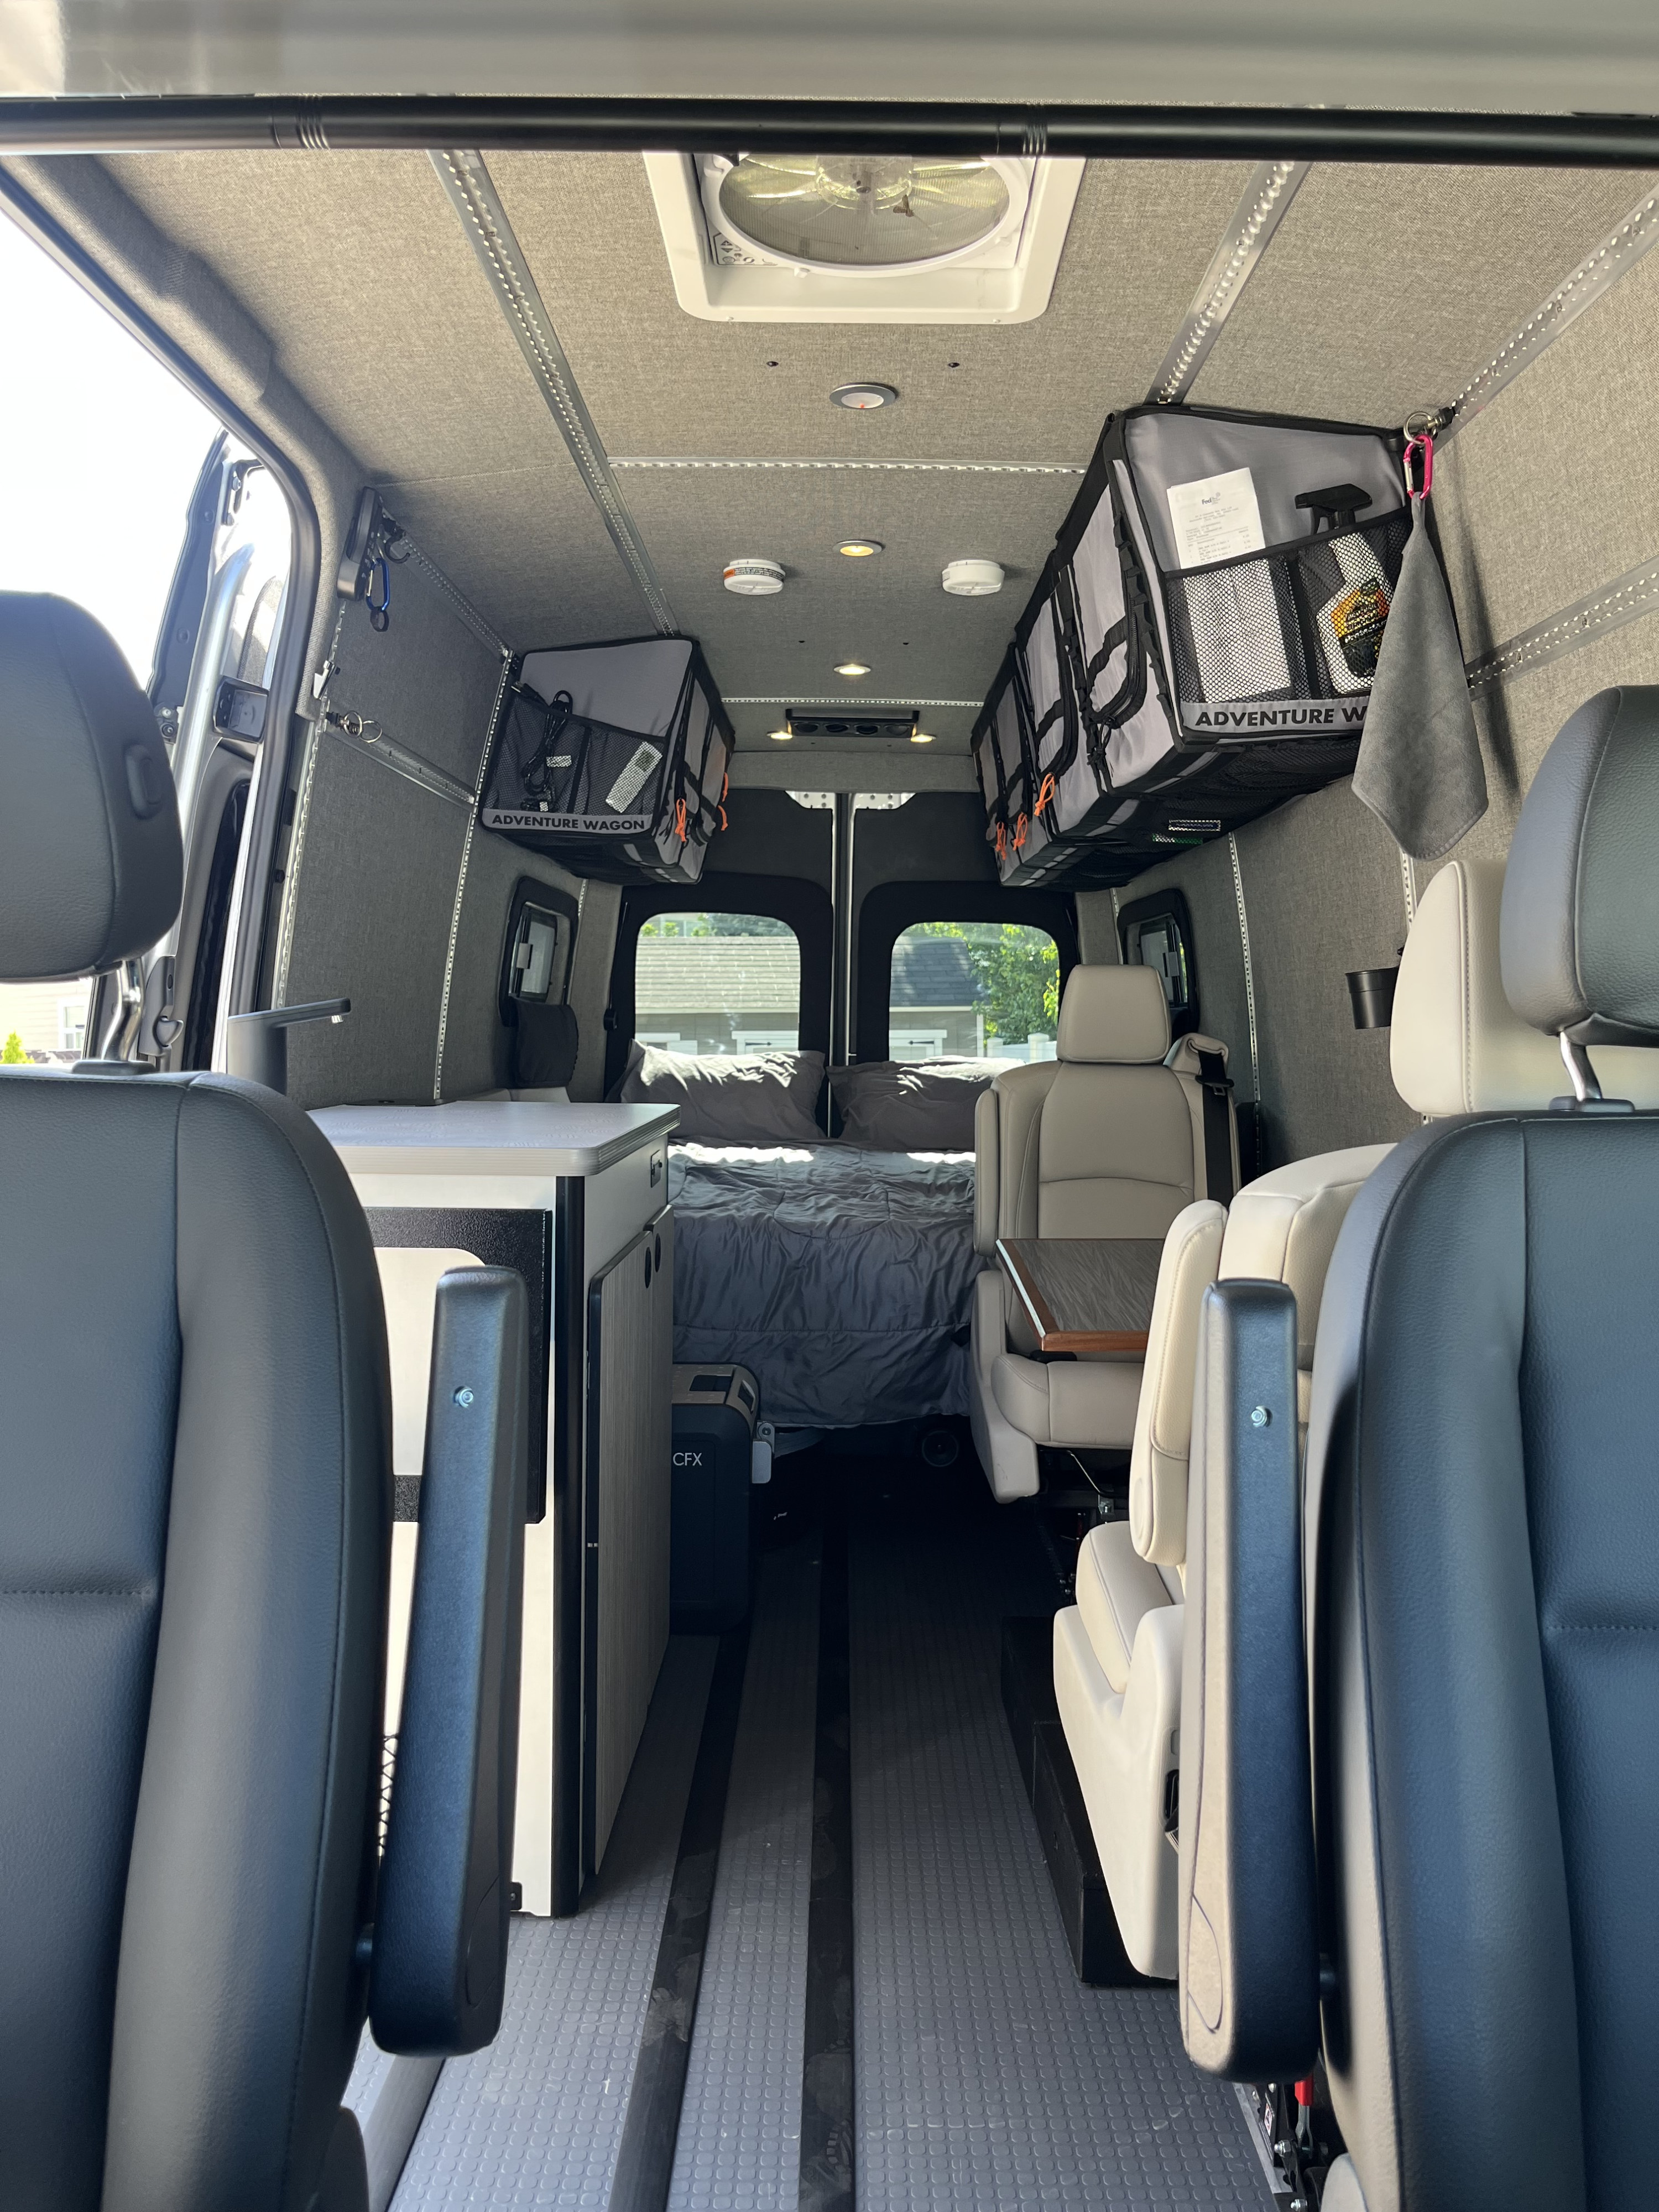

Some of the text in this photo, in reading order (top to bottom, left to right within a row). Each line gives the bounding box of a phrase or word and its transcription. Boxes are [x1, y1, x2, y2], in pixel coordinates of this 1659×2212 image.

[1195, 708, 1335, 726] ADVENTURE
[492, 815, 645, 831] ADVENTURE WAGON
[672, 1452, 702, 1466] CFX
